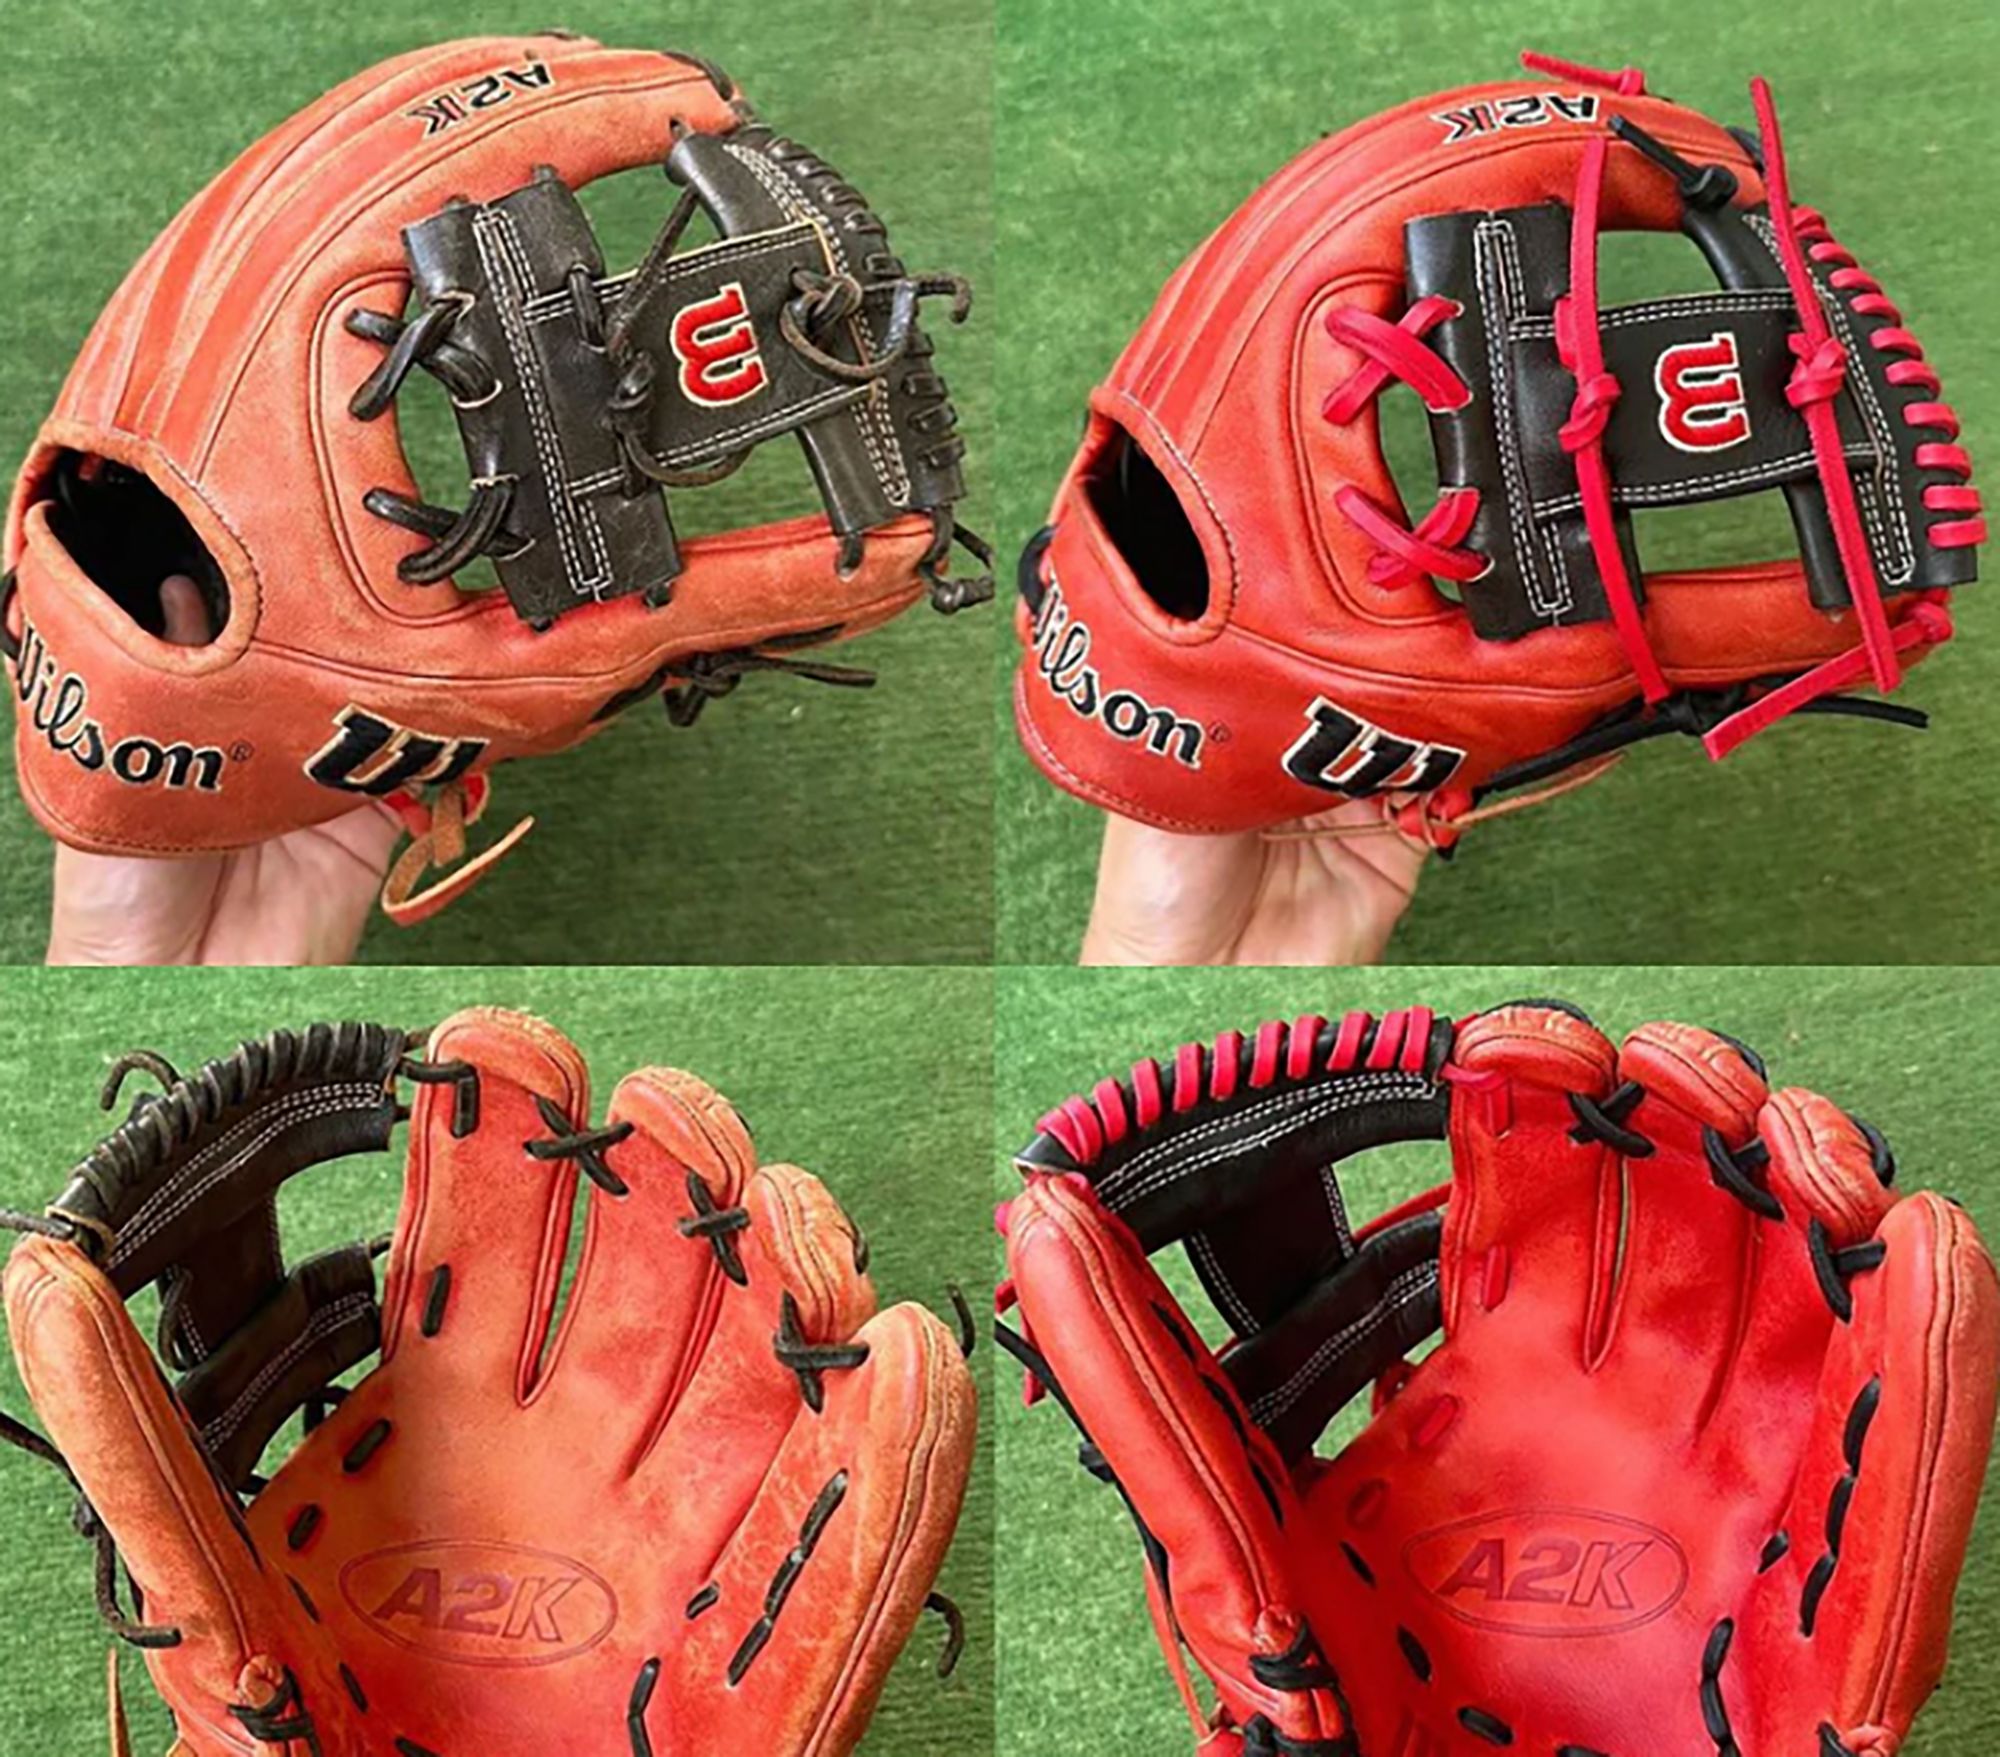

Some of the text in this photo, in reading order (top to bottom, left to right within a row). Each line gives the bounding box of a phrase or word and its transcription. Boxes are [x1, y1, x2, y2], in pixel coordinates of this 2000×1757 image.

[405, 62, 556, 139] A2K
[1429, 93, 1599, 145] A2K
[372, 1566, 584, 1643] A2K
[1431, 1534, 1655, 1610] A2K
